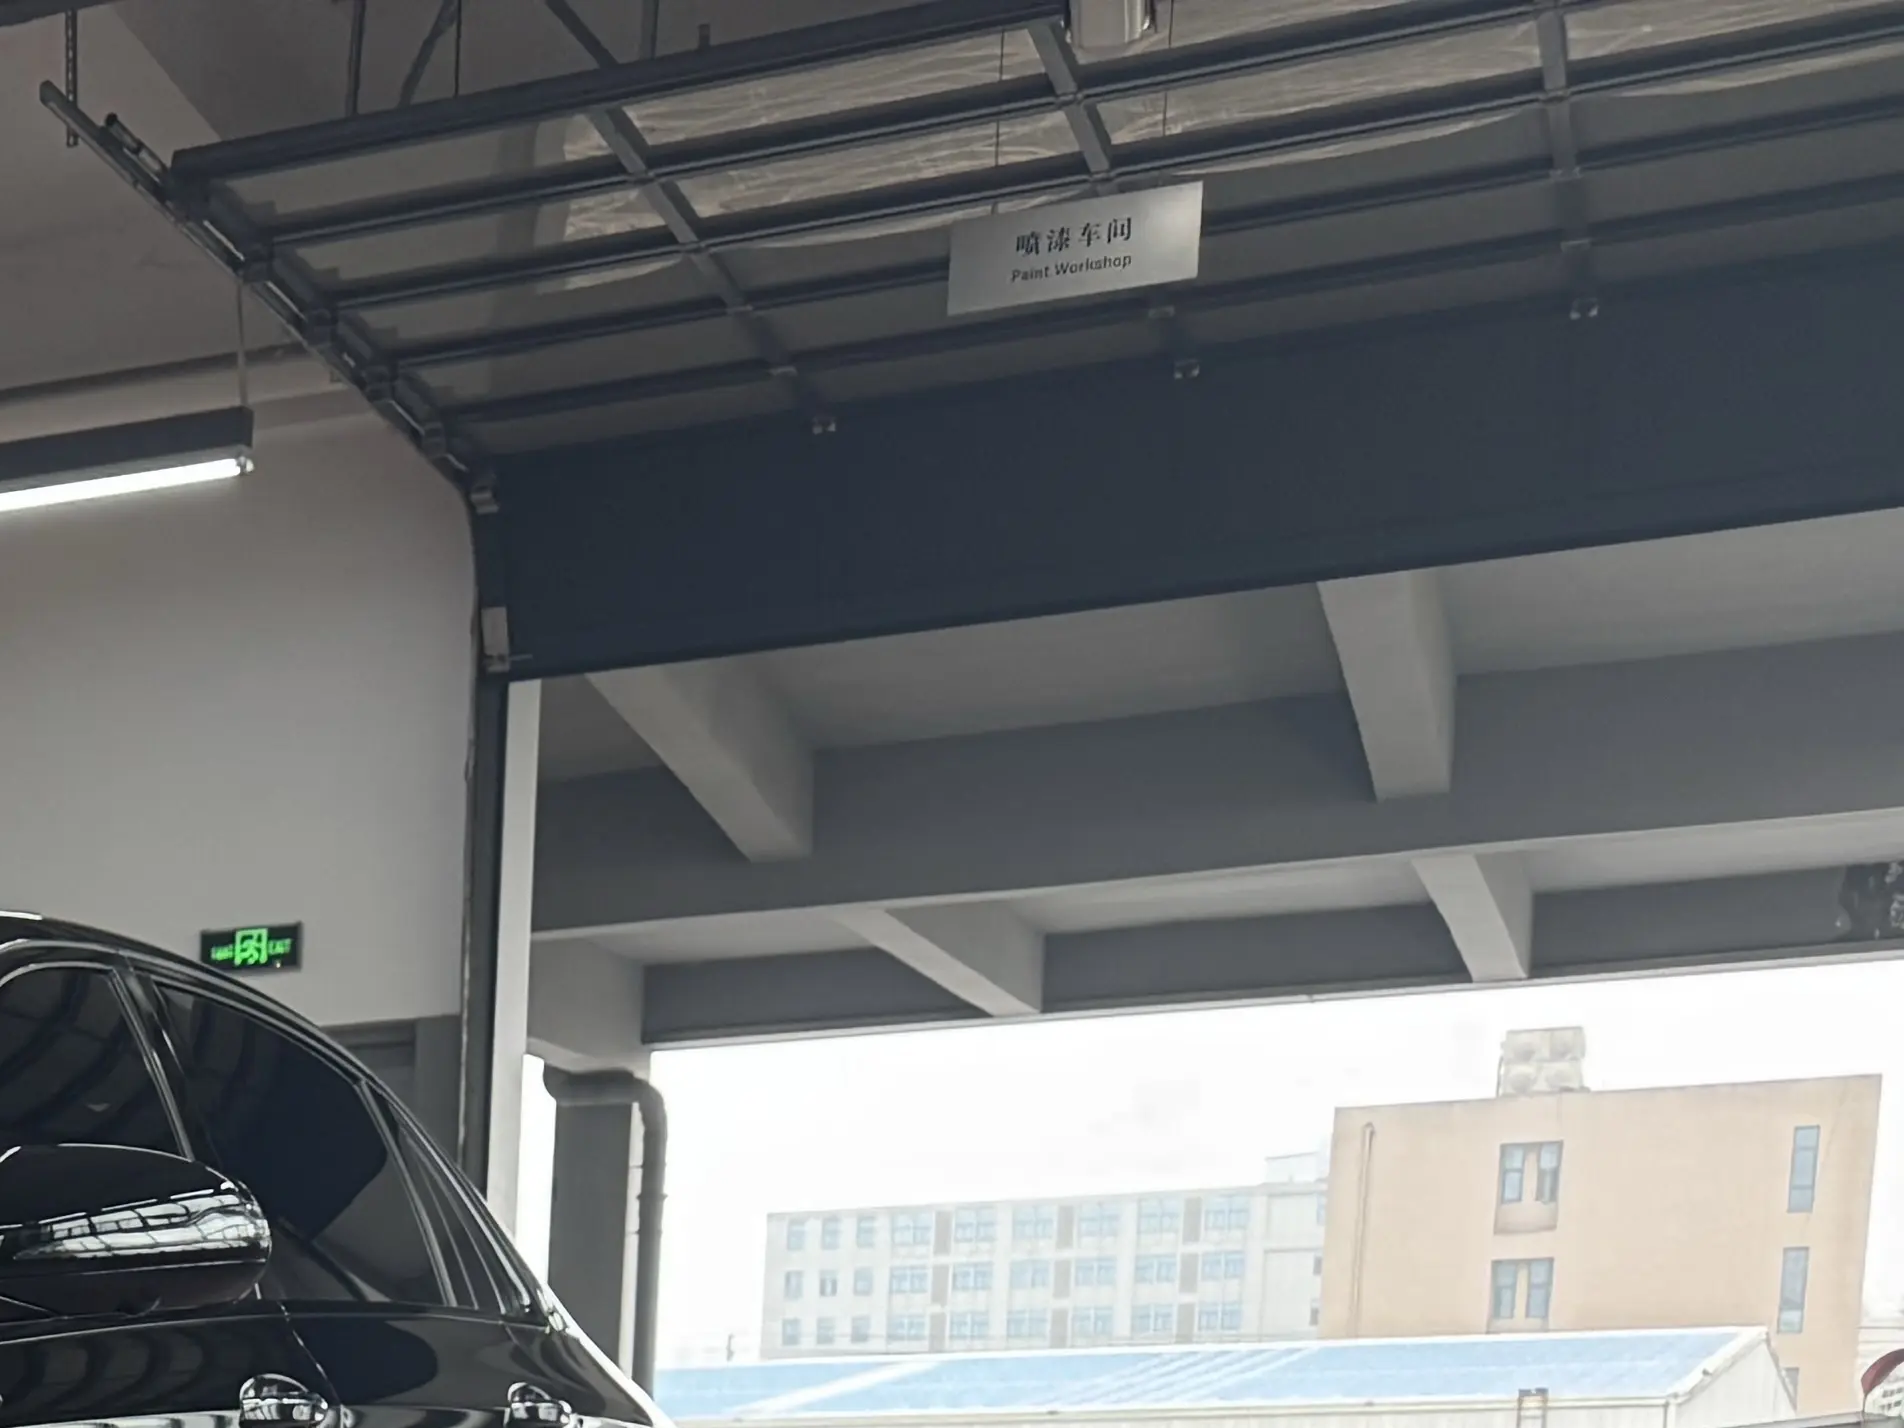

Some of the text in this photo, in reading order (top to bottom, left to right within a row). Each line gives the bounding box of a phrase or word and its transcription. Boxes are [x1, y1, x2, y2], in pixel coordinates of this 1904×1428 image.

[1016, 217, 1131, 255] 喷漆车间
[1011, 255, 1133, 282] Paint Workshop
